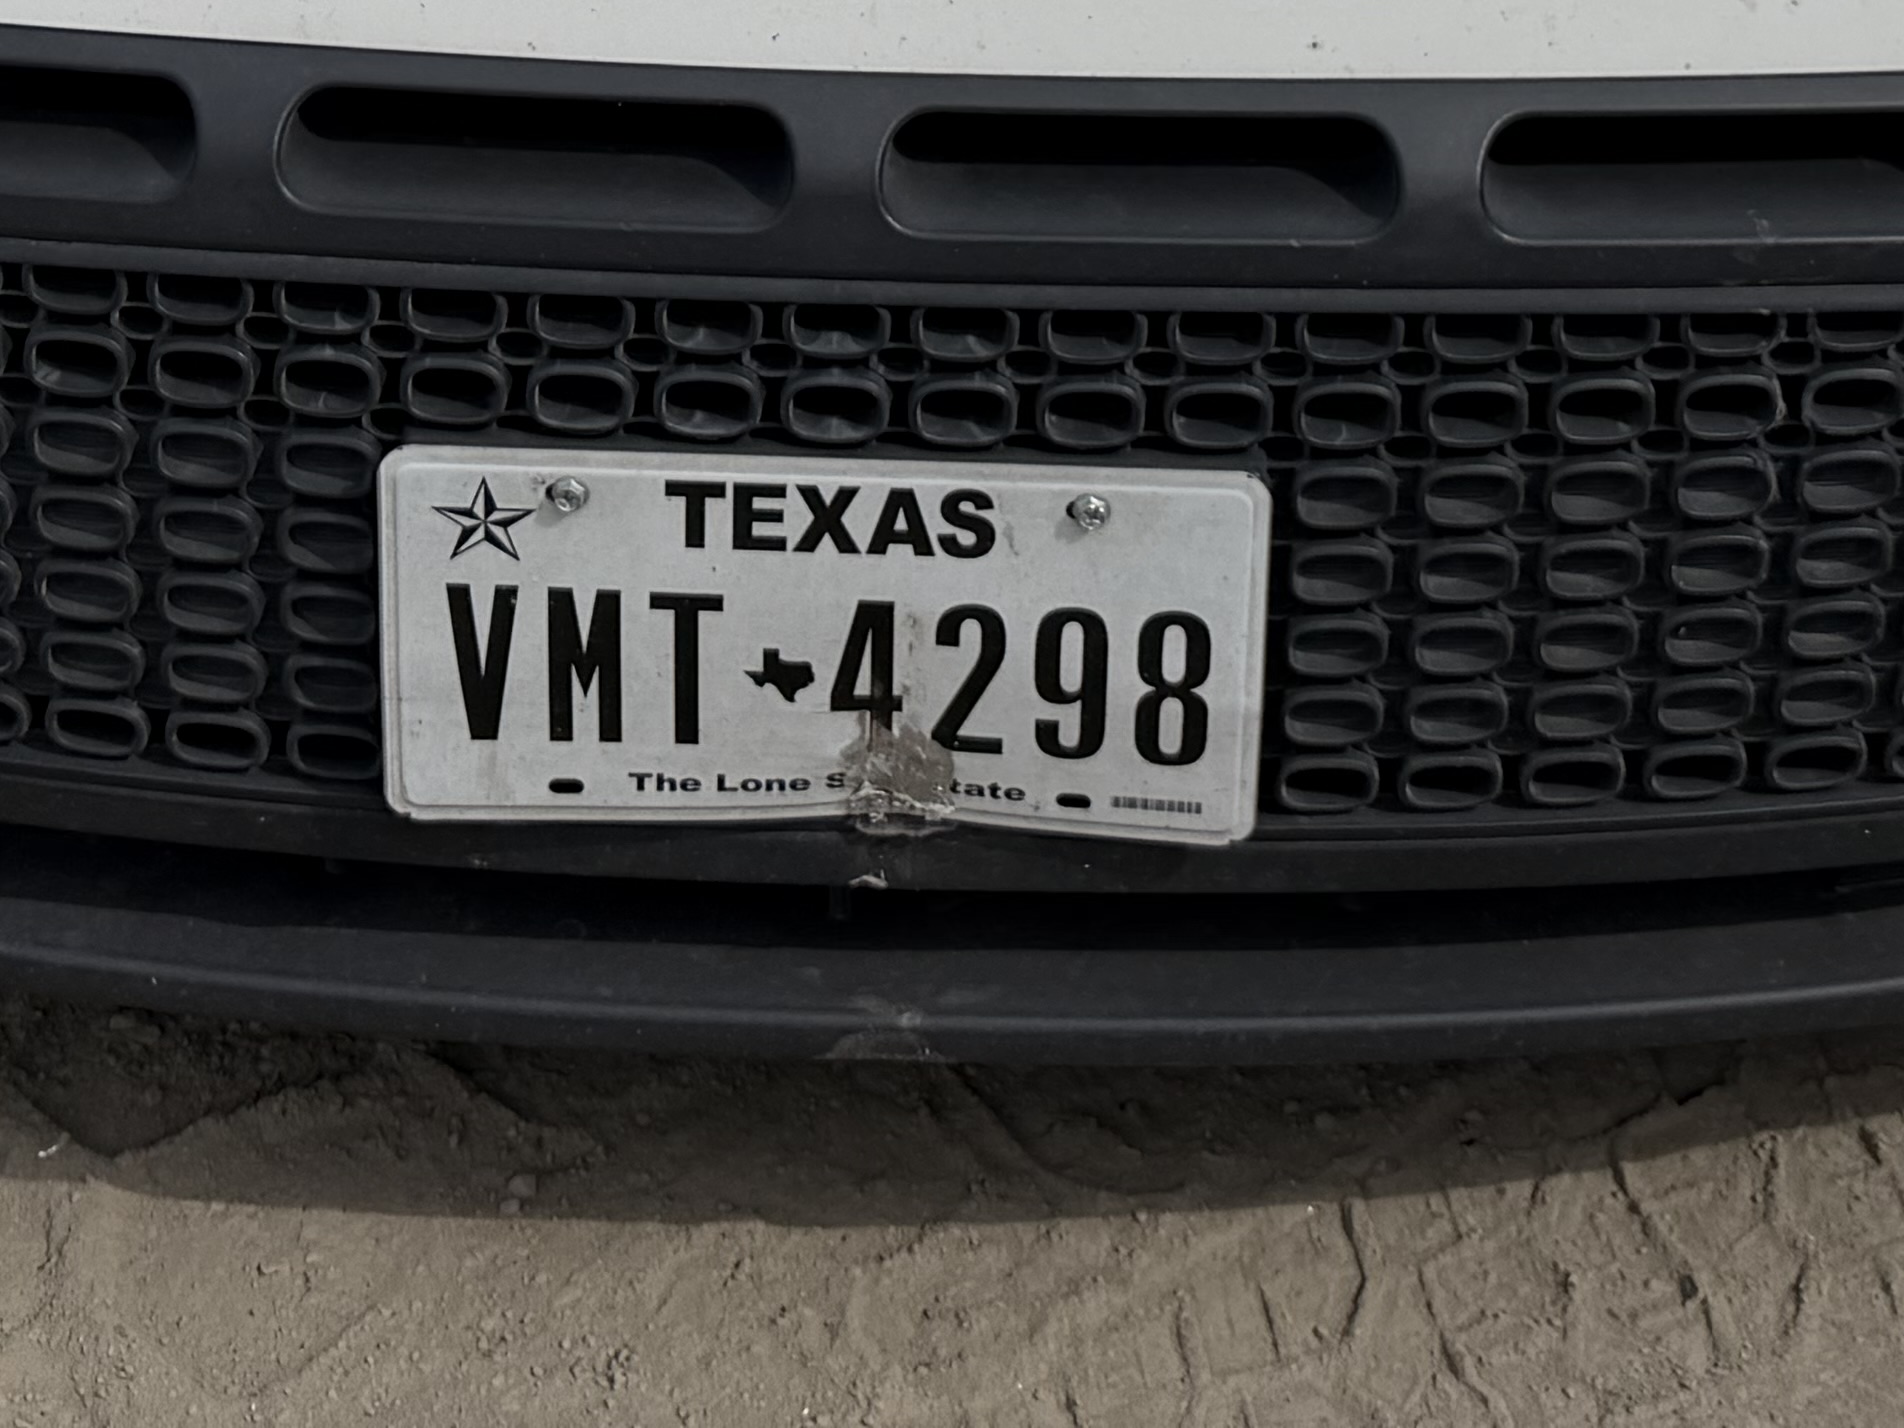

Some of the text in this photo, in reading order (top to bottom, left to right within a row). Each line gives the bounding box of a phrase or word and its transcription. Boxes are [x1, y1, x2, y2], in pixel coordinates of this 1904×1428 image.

[664, 480, 997, 559] TEXAS
[446, 583, 1212, 767] VMT 4298
[628, 772, 703, 793] The
[716, 773, 812, 794] Lone
[948, 778, 1027, 802] tate
